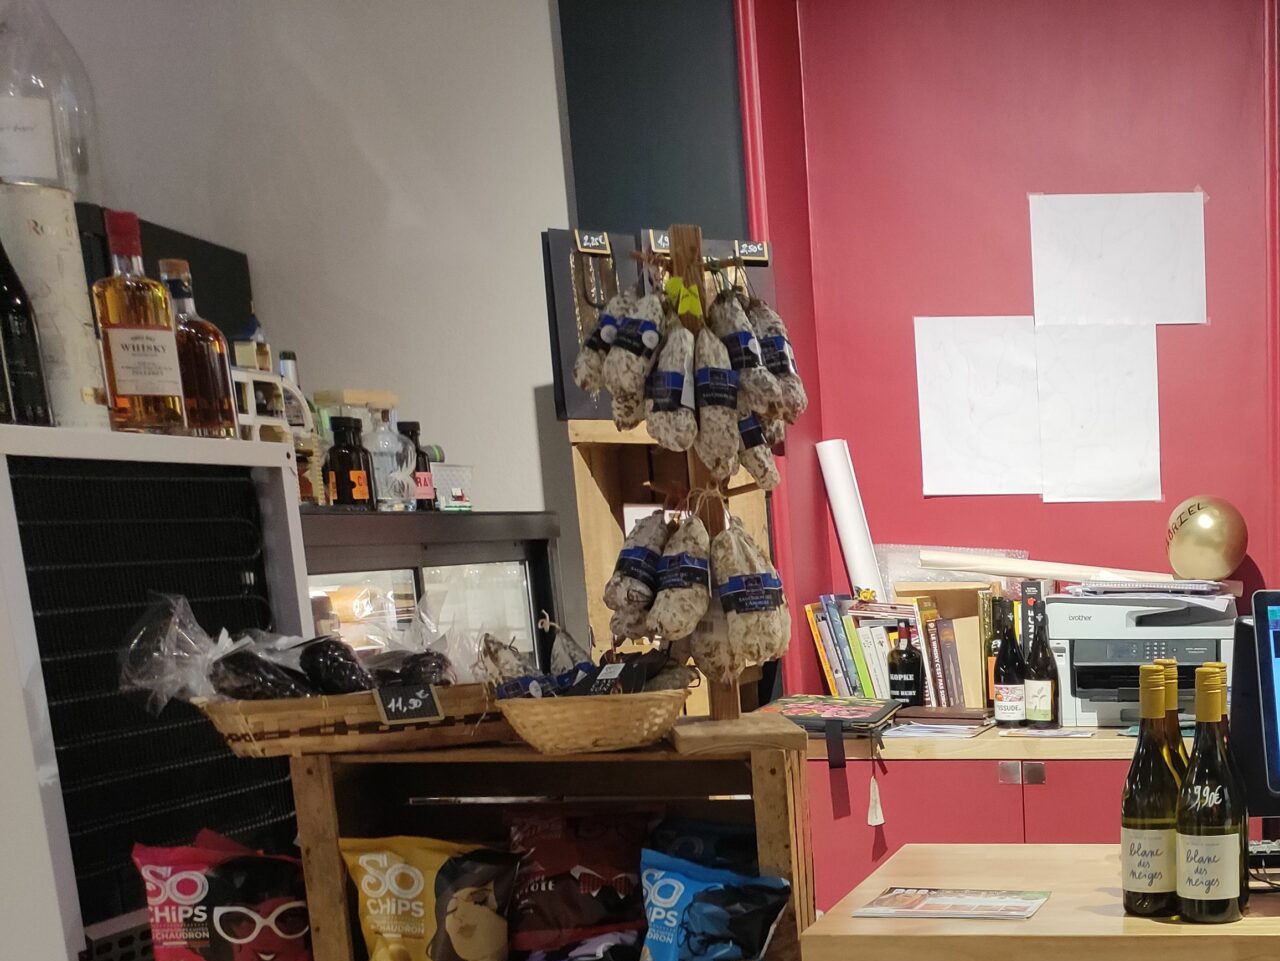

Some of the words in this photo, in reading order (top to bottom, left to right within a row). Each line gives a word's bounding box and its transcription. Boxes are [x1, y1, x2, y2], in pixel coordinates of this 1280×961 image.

[658, 234, 669, 246] 1,9
[121, 344, 167, 353] WHISKY
[1068, 614, 1092, 622] brother
[1129, 842, 1163, 857] blanc
[1186, 849, 1221, 864] blanc
[1137, 859, 1150, 869] des
[359, 853, 424, 898] SO
[1130, 869, 1163, 886] neiges
[1194, 866, 1207, 876] des
[1186, 875, 1220, 893] neiges
